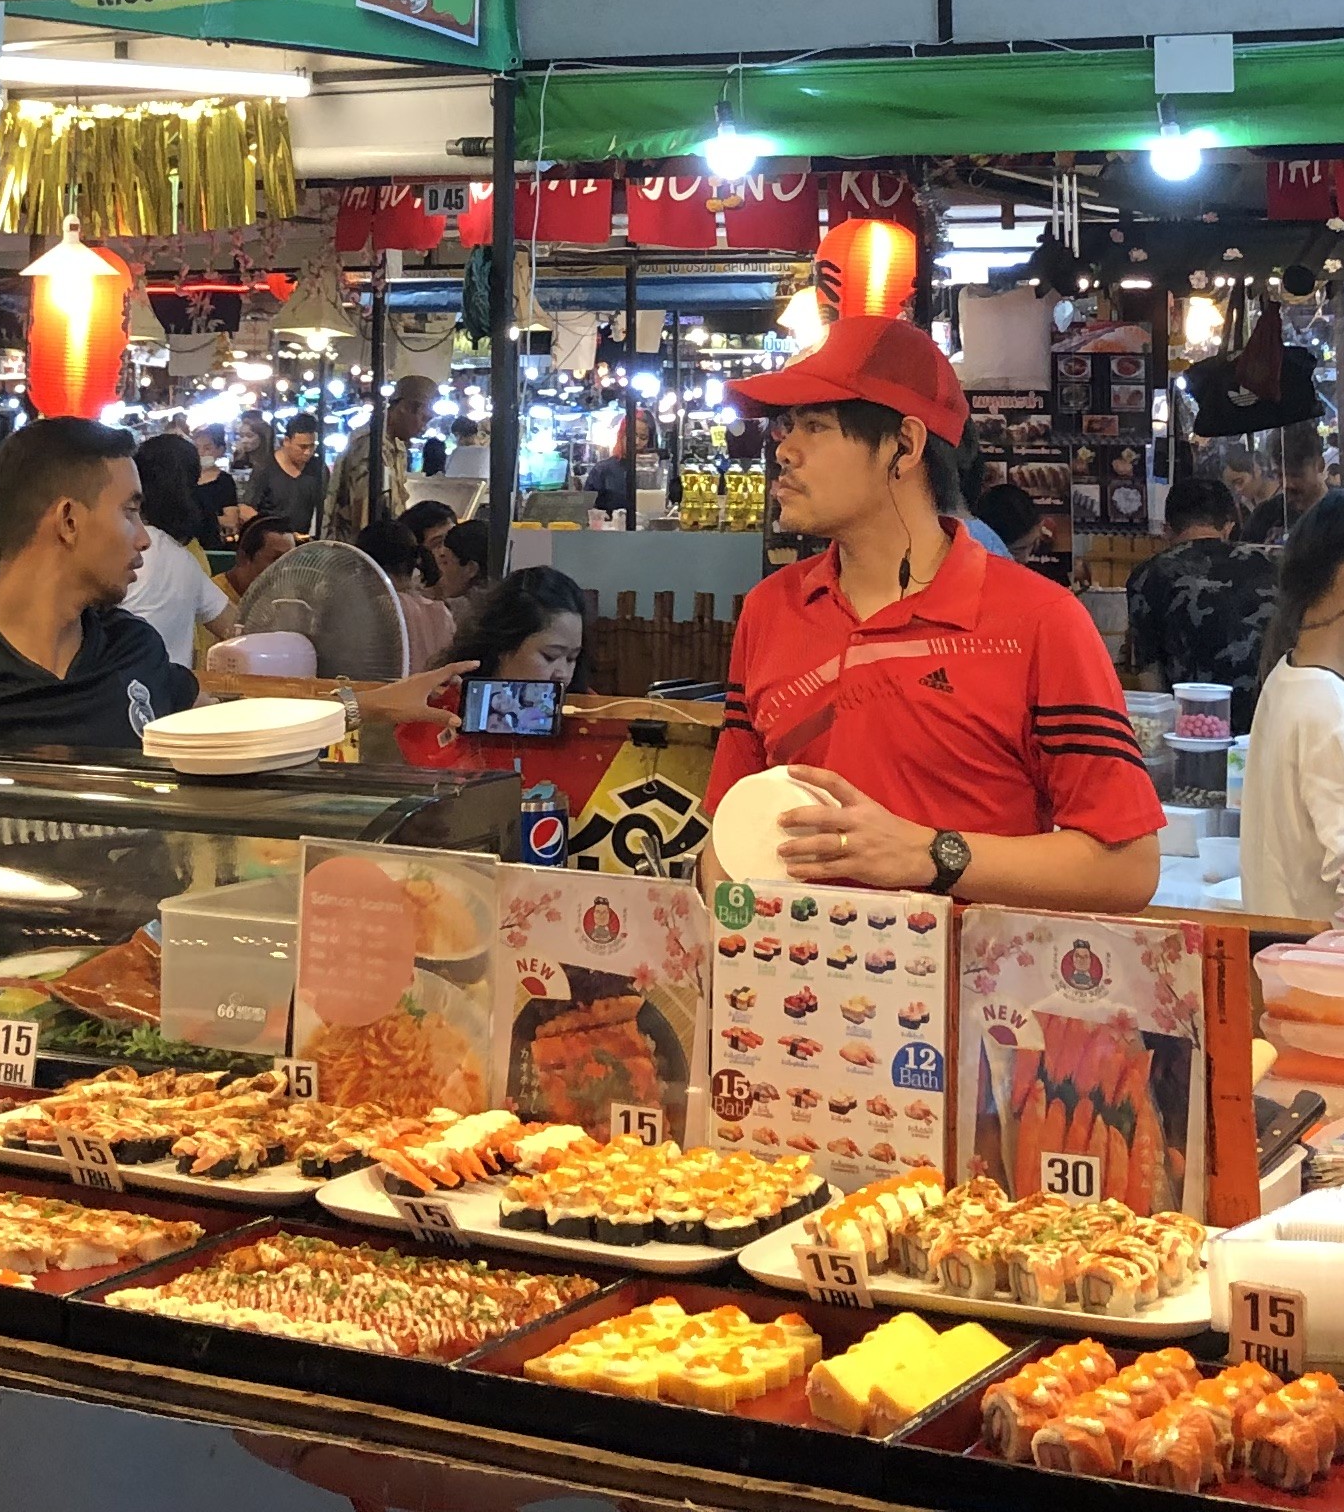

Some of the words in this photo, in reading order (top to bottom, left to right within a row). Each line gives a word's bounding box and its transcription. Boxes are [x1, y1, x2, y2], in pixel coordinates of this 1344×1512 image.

[729, 886, 745, 908] 6
[516, 958, 555, 980] NEW
[217, 1003, 235, 1019] 66
[983, 1004, 1029, 1030] NEW
[1, 1024, 34, 1056] 15
[905, 1046, 936, 1071] 12
[281, 1064, 312, 1099] 15
[719, 1074, 750, 1100] 15
[899, 1066, 939, 1090] Bath
[619, 1109, 657, 1147] 15
[66, 1135, 109, 1166] 15
[1047, 1157, 1095, 1197] 30
[404, 1201, 452, 1228] 15
[806, 1252, 857, 1286] 15
[1243, 1292, 1295, 1338] 15
